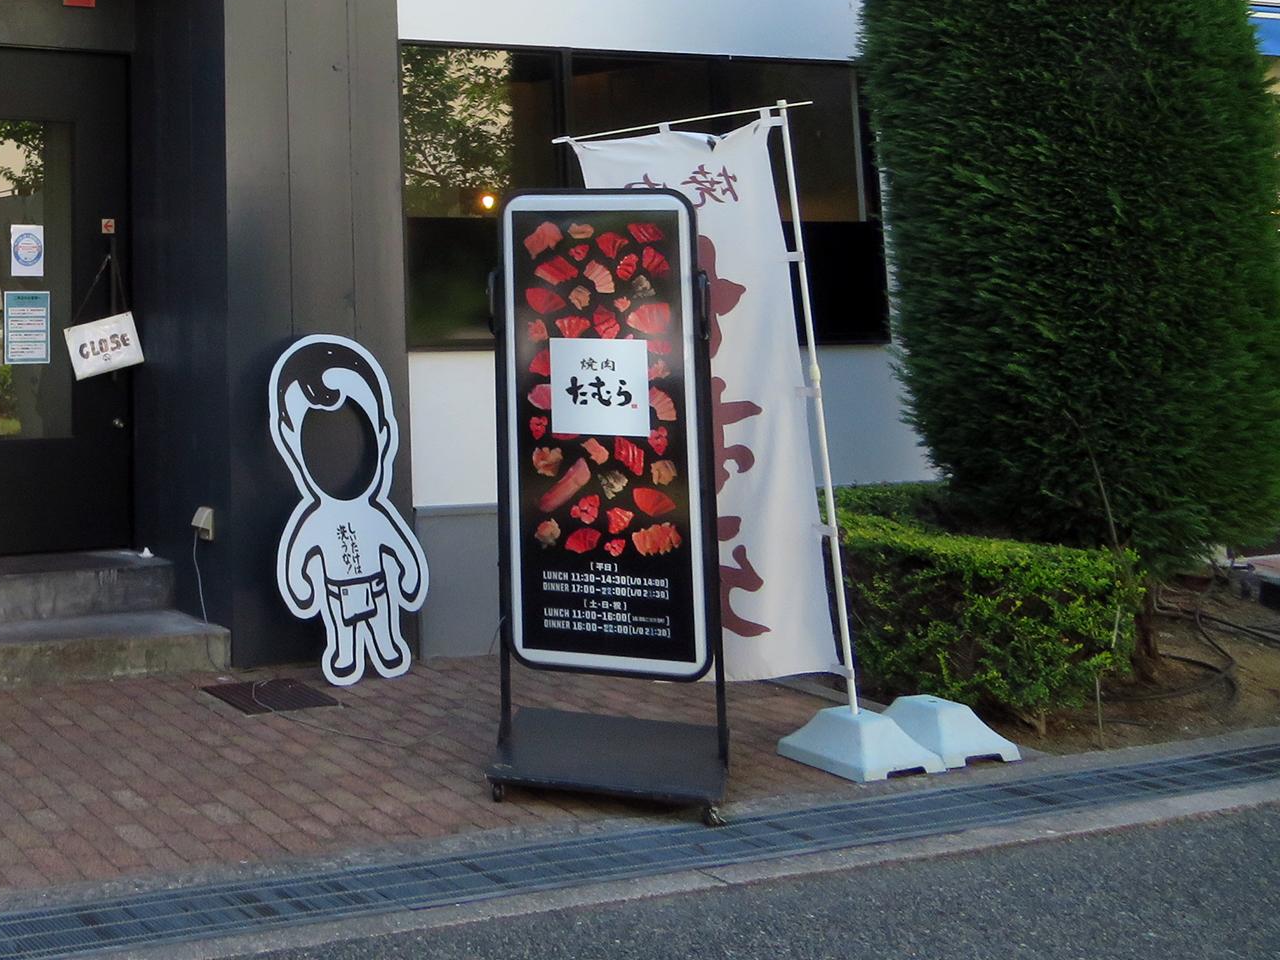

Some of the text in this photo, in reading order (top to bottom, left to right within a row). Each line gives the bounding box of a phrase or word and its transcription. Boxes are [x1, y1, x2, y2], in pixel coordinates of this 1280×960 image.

[78, 332, 131, 360] CLOSE
[580, 357, 616, 371] 焼肉
[565, 375, 633, 407] たむら
[347, 522, 363, 575] しいたけは
[542, 571, 569, 581] LUNCH
[542, 581, 570, 592] DINNER
[543, 607, 570, 618] LUNCH
[543, 619, 571, 629] DINNER
